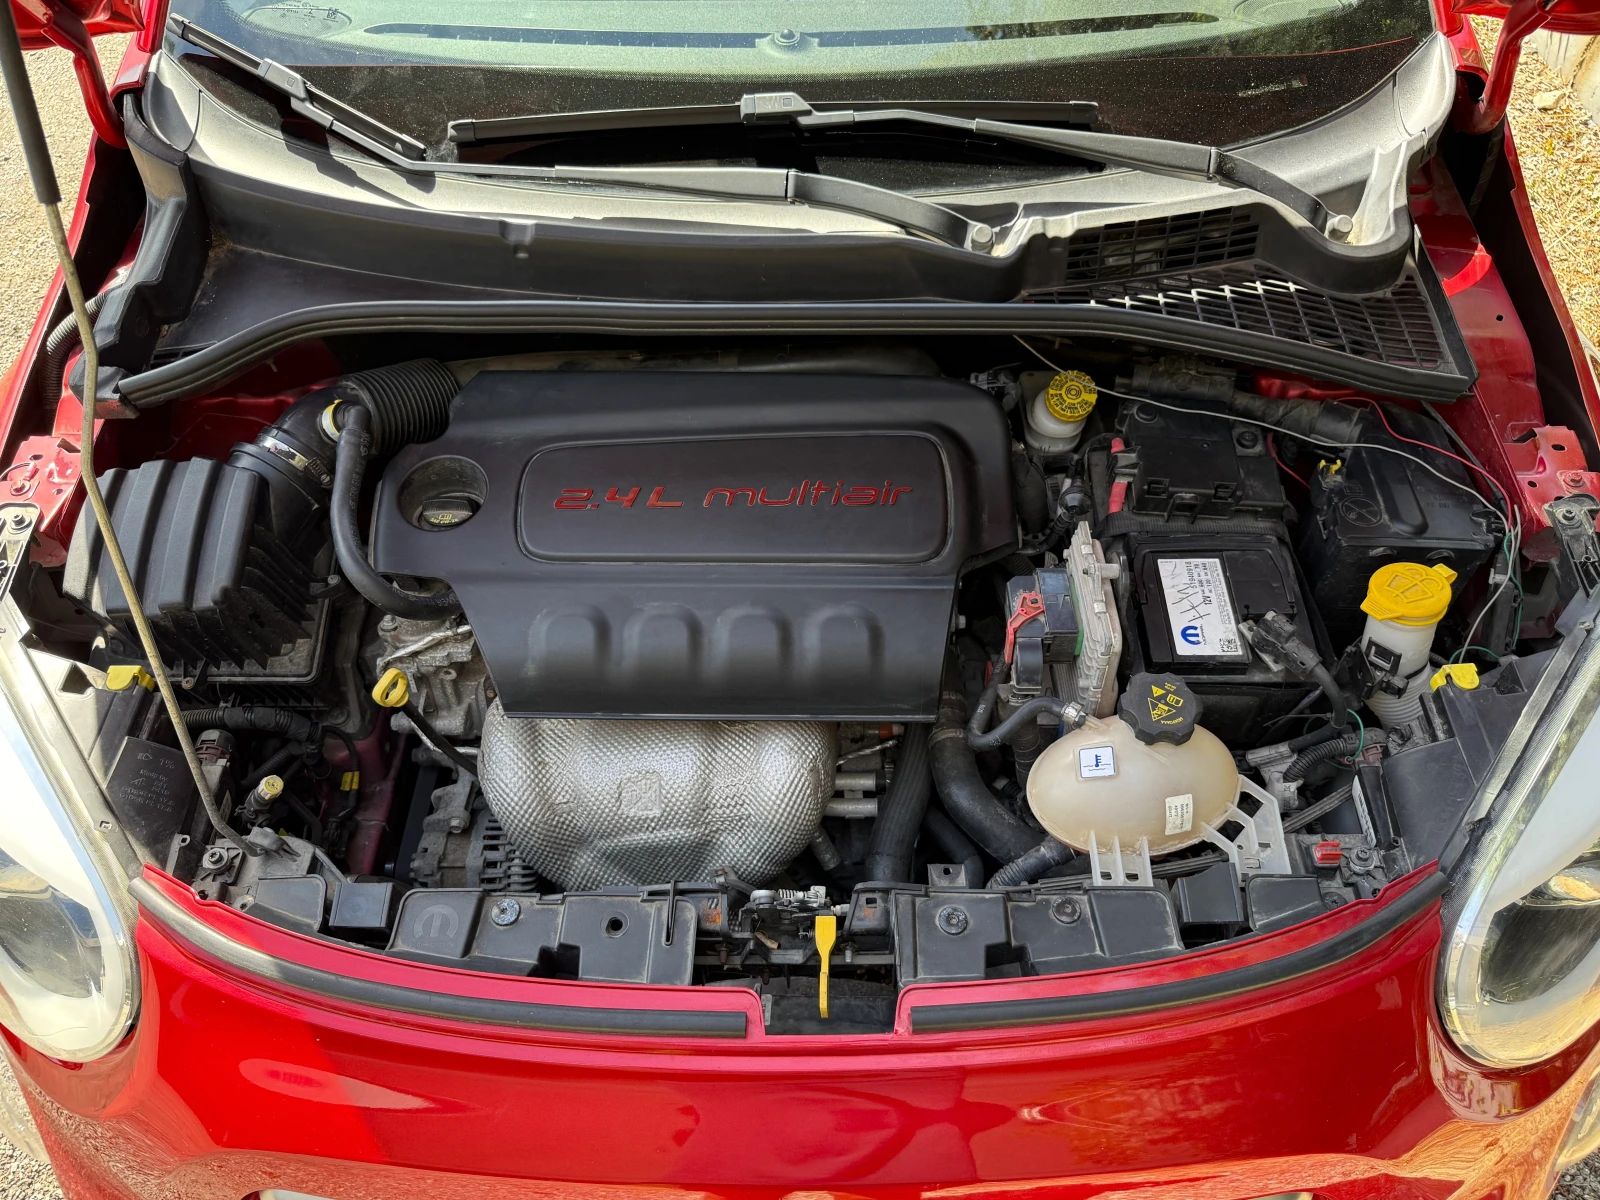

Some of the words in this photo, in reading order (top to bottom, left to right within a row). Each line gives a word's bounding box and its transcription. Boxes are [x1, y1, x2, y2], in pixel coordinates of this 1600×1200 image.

[702, 479, 913, 507] multiair
[1184, 561, 1198, 589] 51940918
[1202, 595, 1212, 605] 12V
